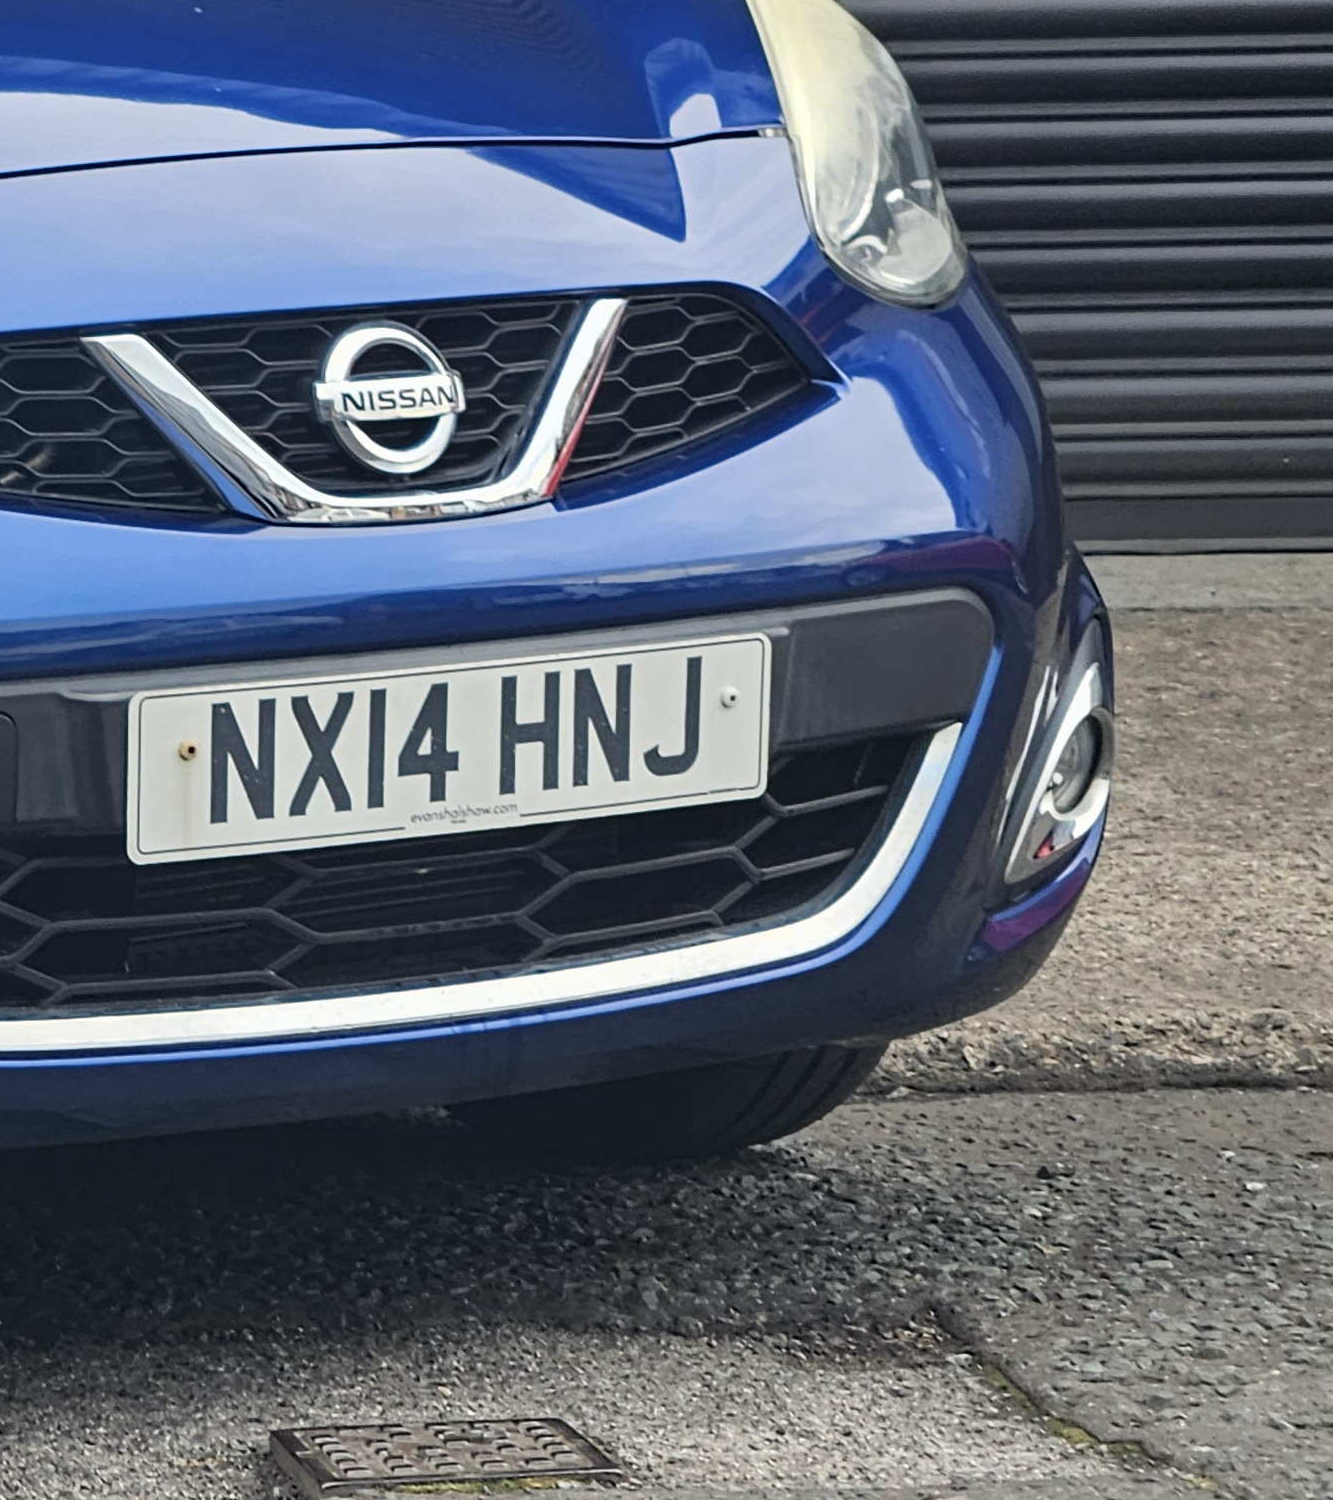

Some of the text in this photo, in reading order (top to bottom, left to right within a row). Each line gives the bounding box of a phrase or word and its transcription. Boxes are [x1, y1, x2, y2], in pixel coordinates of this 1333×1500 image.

[341, 385, 455, 412] NISSAN
[209, 656, 703, 824] NX14 HNJ
